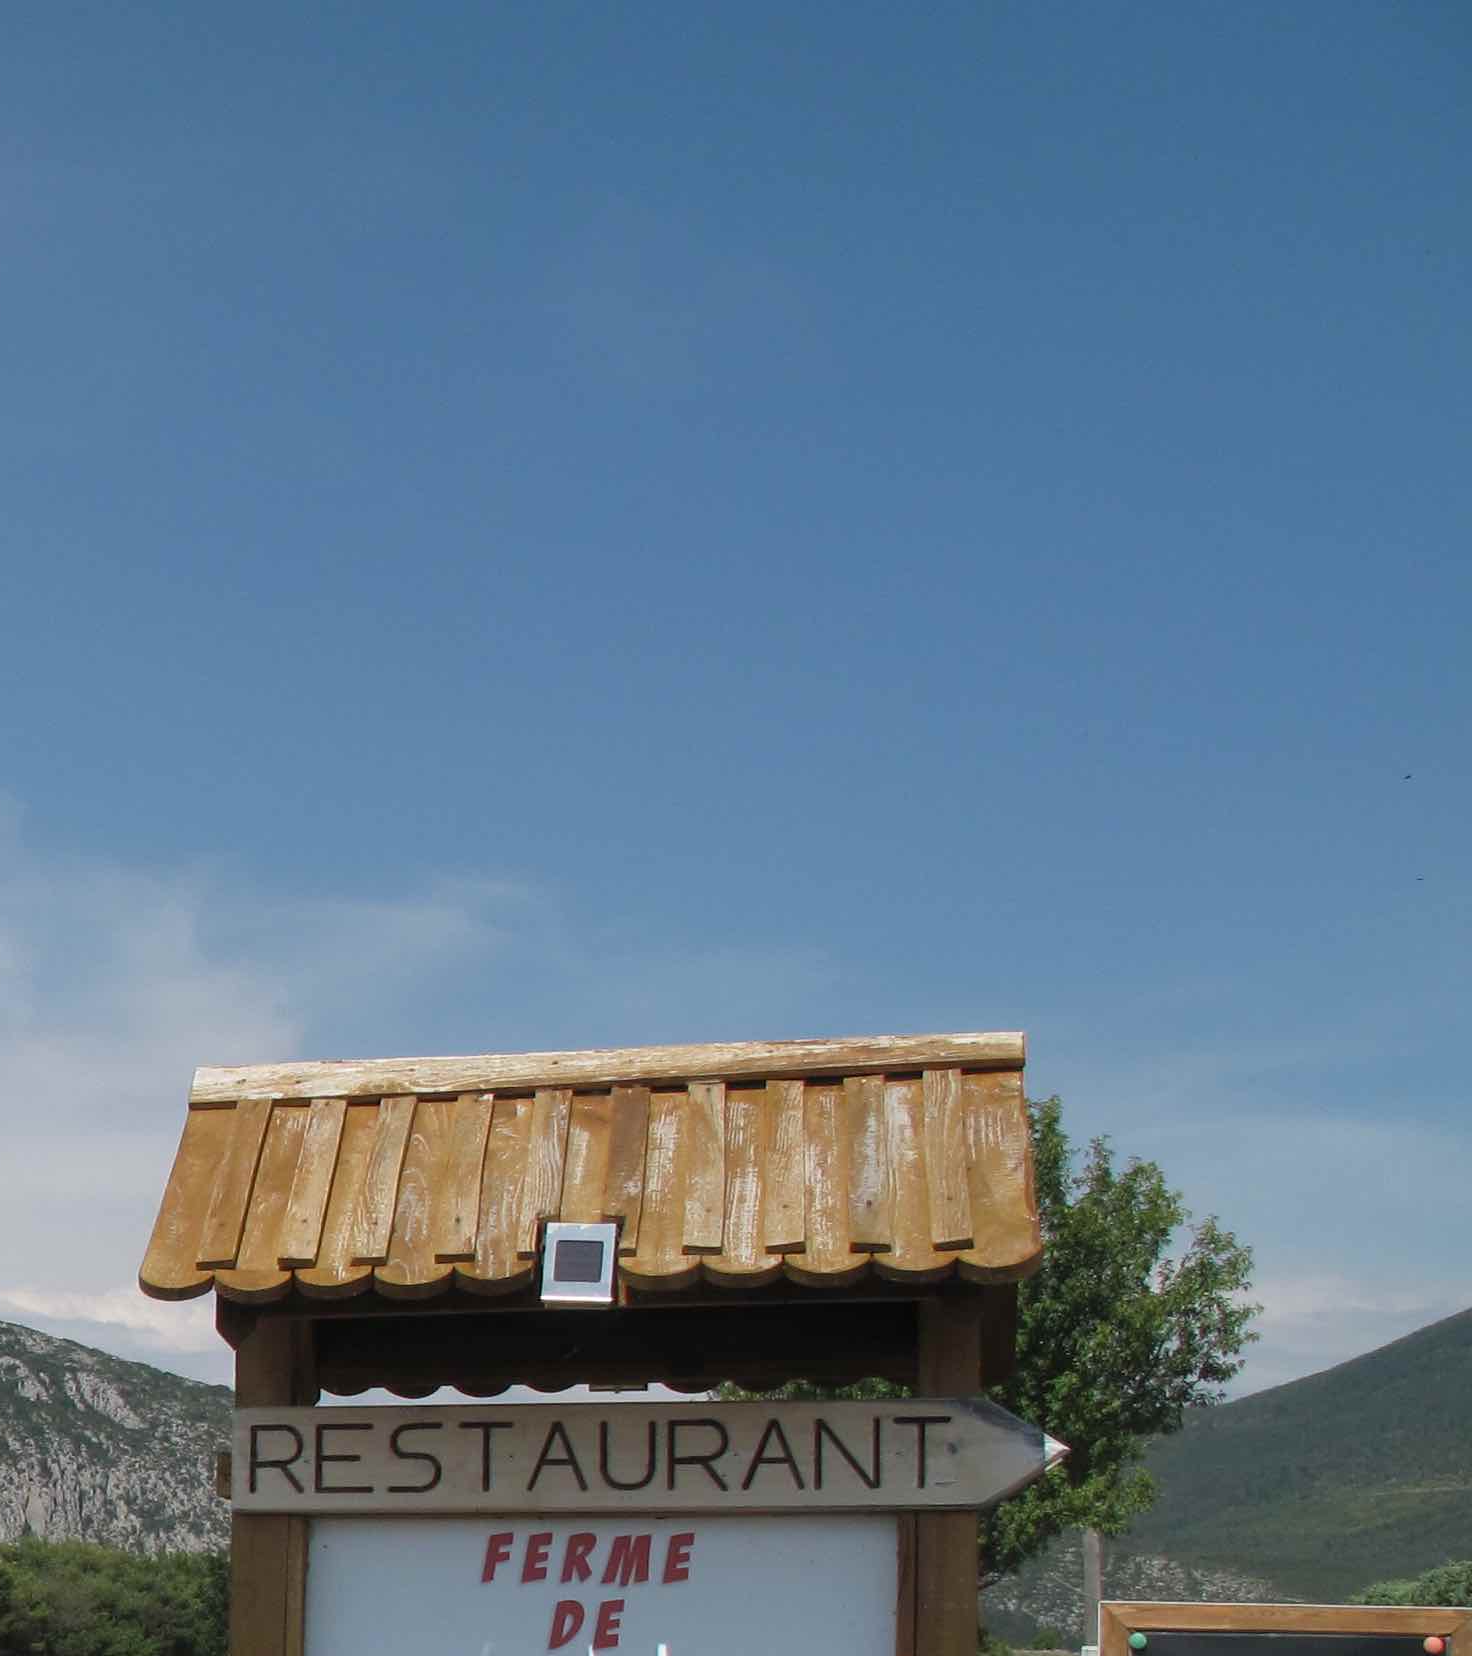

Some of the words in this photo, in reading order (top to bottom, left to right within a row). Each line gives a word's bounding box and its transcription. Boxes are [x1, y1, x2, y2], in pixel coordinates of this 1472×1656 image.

[248, 1415, 953, 1494] RESTAURANT
[481, 1532, 695, 1586] FERME
[548, 1599, 625, 1650] DE
